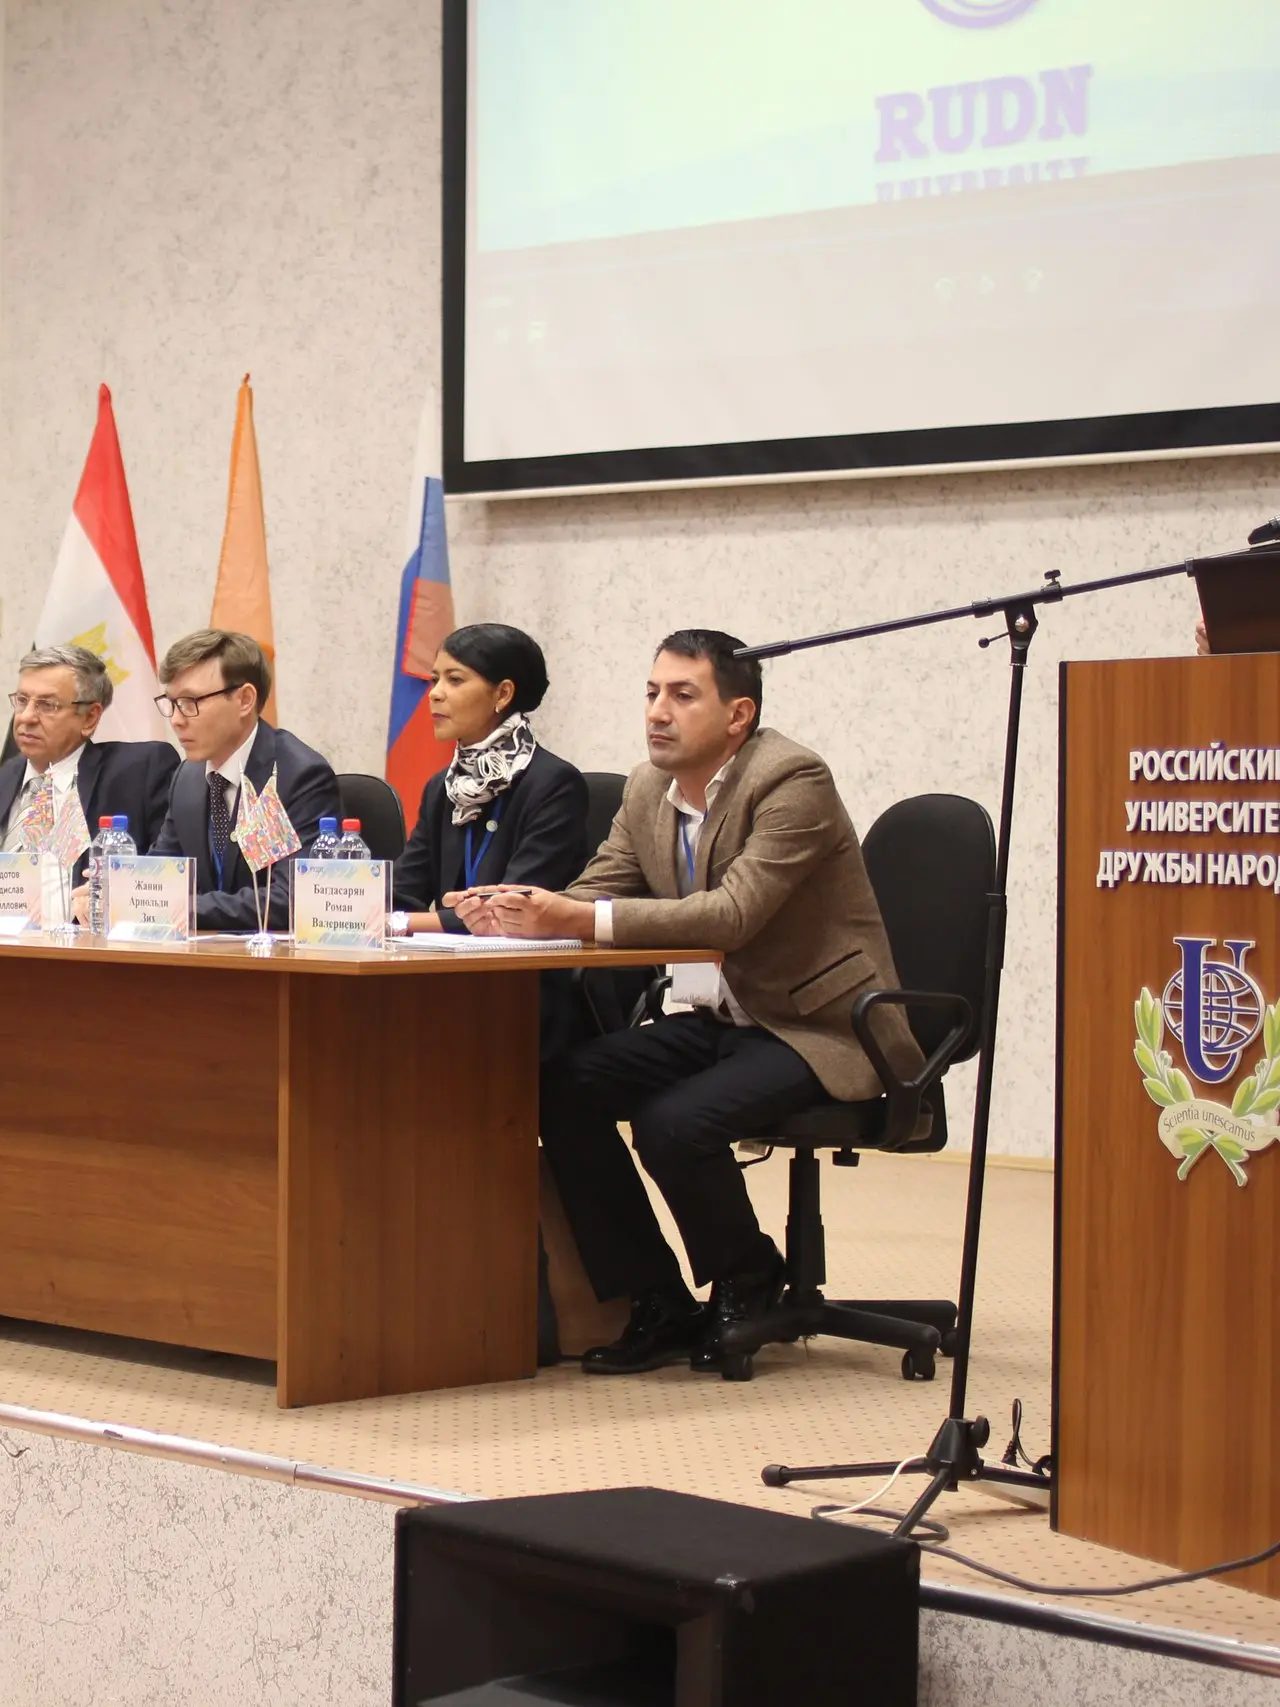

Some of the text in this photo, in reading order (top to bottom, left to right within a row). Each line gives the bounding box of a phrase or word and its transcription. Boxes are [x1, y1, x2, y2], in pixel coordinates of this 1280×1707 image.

[874, 63, 1094, 163] RUDN
[1129, 742, 1280, 781] РОССИЙСКИ
[1096, 851, 1202, 888] ДРУЖБЫ
[313, 884, 365, 898] Багдасарян
[325, 901, 353, 912] Роман
[312, 918, 366, 931] Валериевич
[1163, 1103, 1256, 1142] Scientia unescamus
